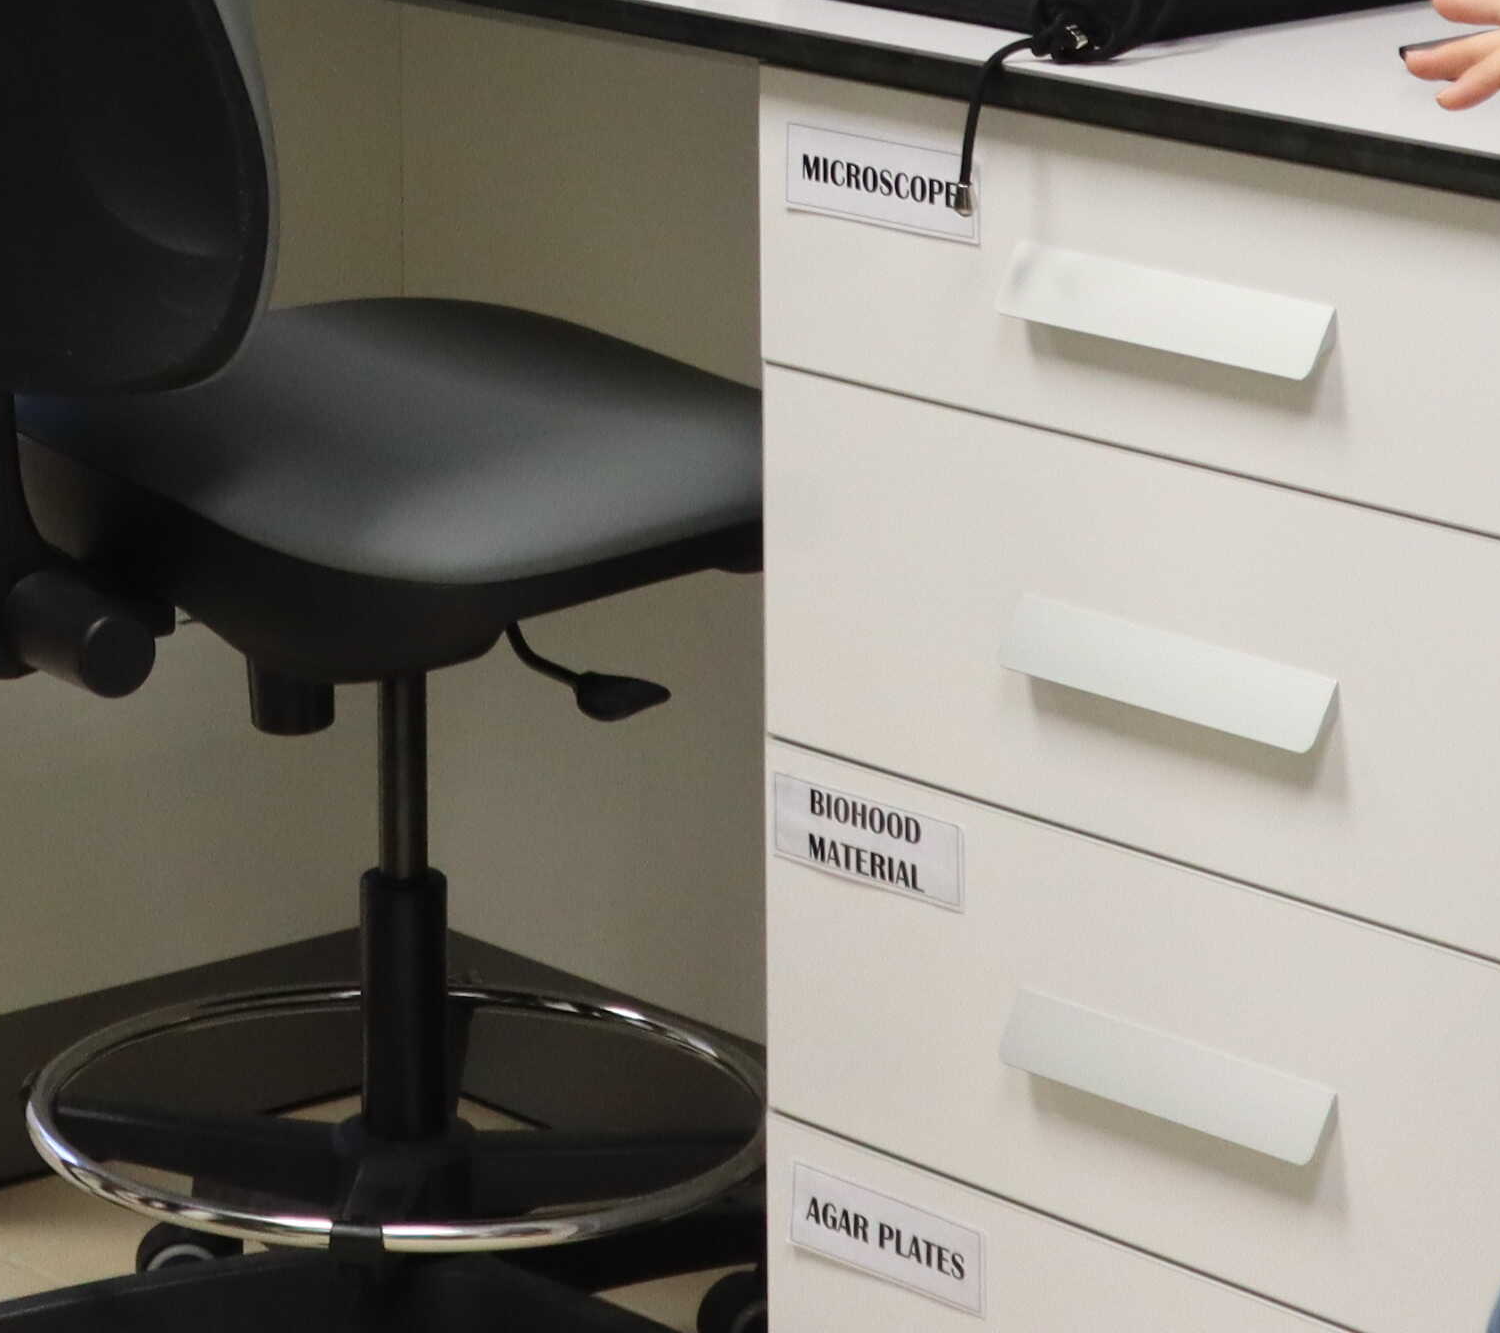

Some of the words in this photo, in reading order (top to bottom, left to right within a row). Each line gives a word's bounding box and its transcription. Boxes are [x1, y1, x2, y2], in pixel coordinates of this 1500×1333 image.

[809, 787, 922, 845] BIOHOOD
[808, 832, 926, 894] MATERIAL
[805, 1195, 870, 1245] AGAR
[878, 1220, 966, 1282] PLATES
